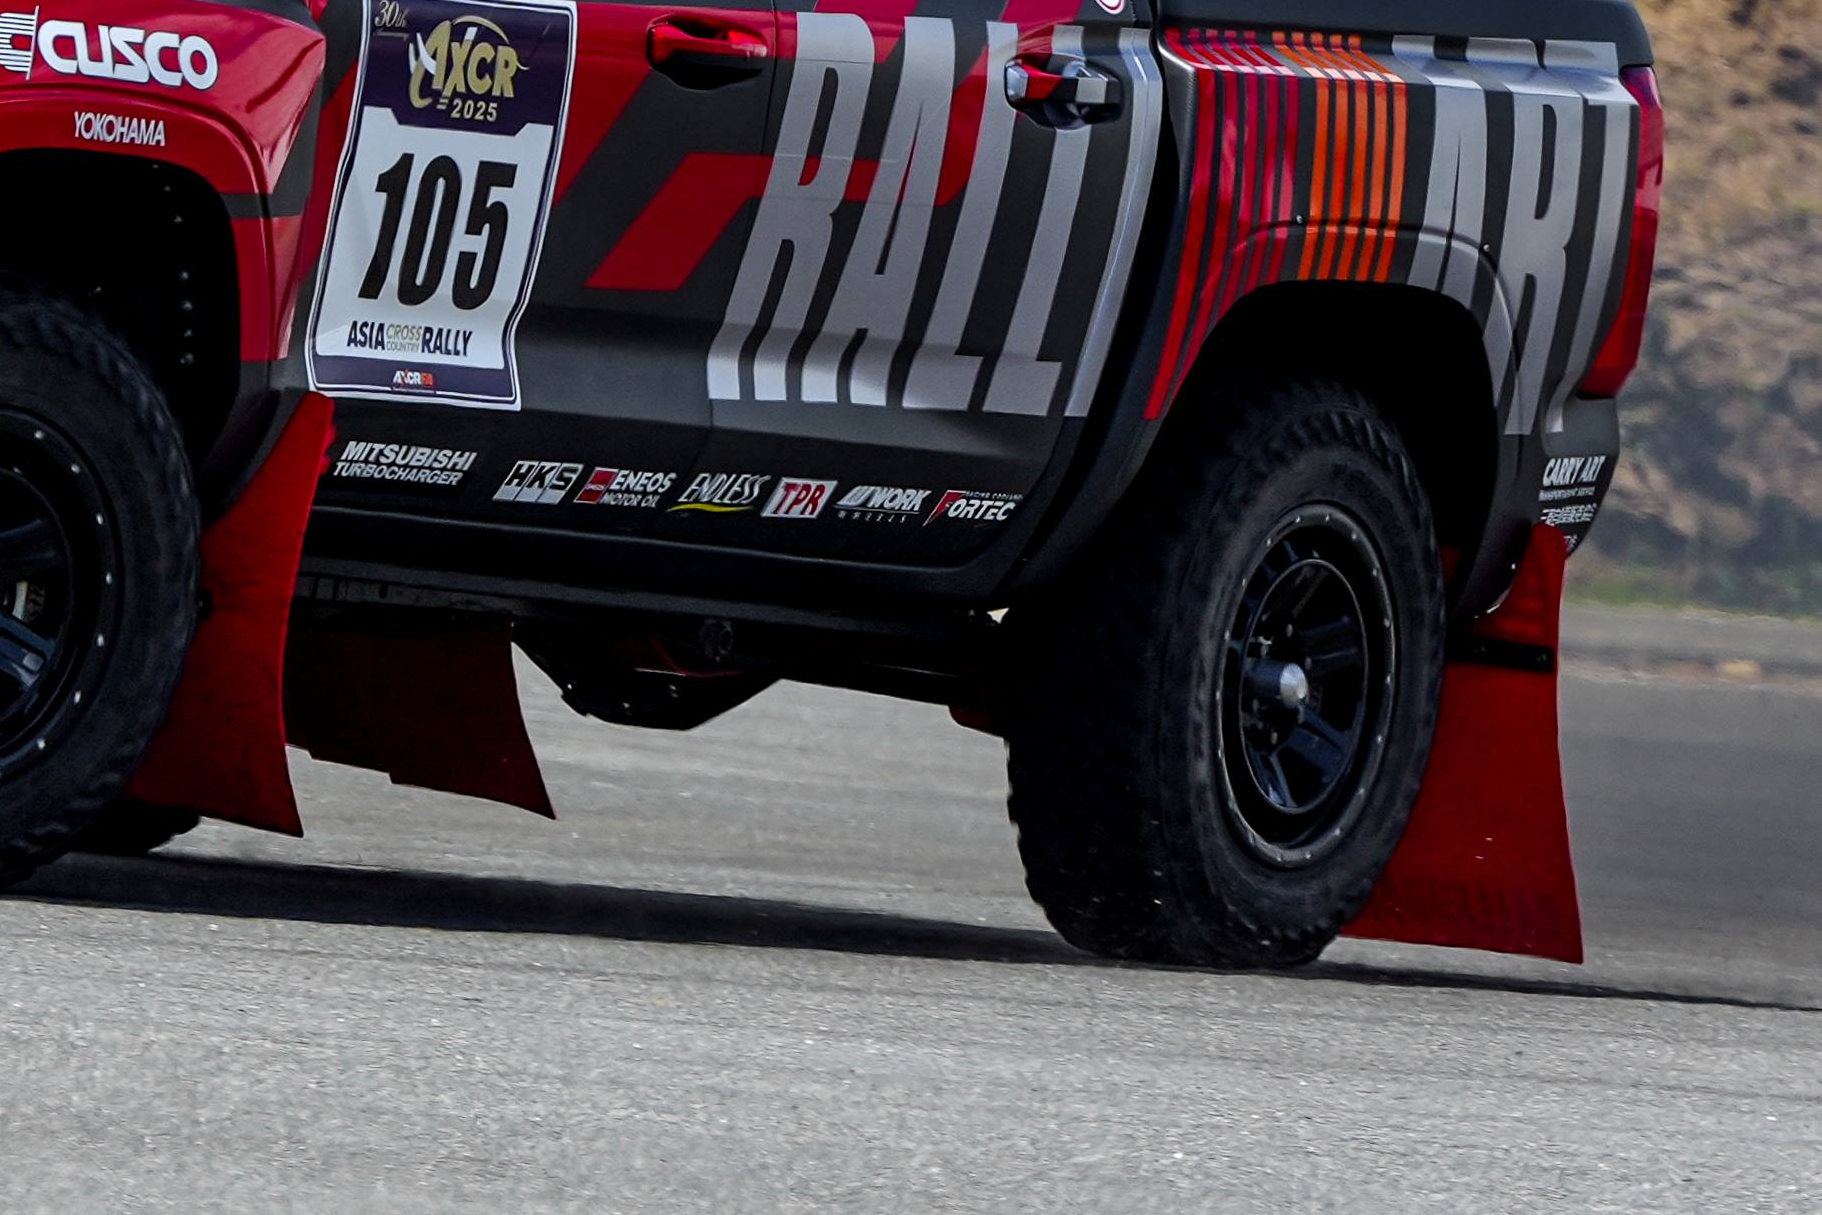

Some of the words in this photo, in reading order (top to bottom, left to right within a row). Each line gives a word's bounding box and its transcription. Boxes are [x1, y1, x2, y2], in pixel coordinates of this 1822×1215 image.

[38, 19, 219, 90] CUSCO
[450, 98, 498, 122] 2025
[74, 111, 166, 147] YOKOHAMA
[357, 152, 518, 312] 105
[346, 320, 385, 351] ASIA
[386, 323, 422, 342] CROSS
[421, 326, 474, 357] RALLY
[341, 440, 477, 471] MITSUBISHI
[1542, 457, 1585, 486] CARRY
[1578, 455, 1606, 483] ART
[333, 462, 462, 485] TURBOCHARGER
[613, 469, 678, 494] ENEOS
[678, 472, 772, 505] ENDLESS
[600, 492, 642, 507] MOTOR
[641, 494, 660, 508] OIL
[775, 482, 827, 517] TPR
[867, 487, 932, 512] WORK
